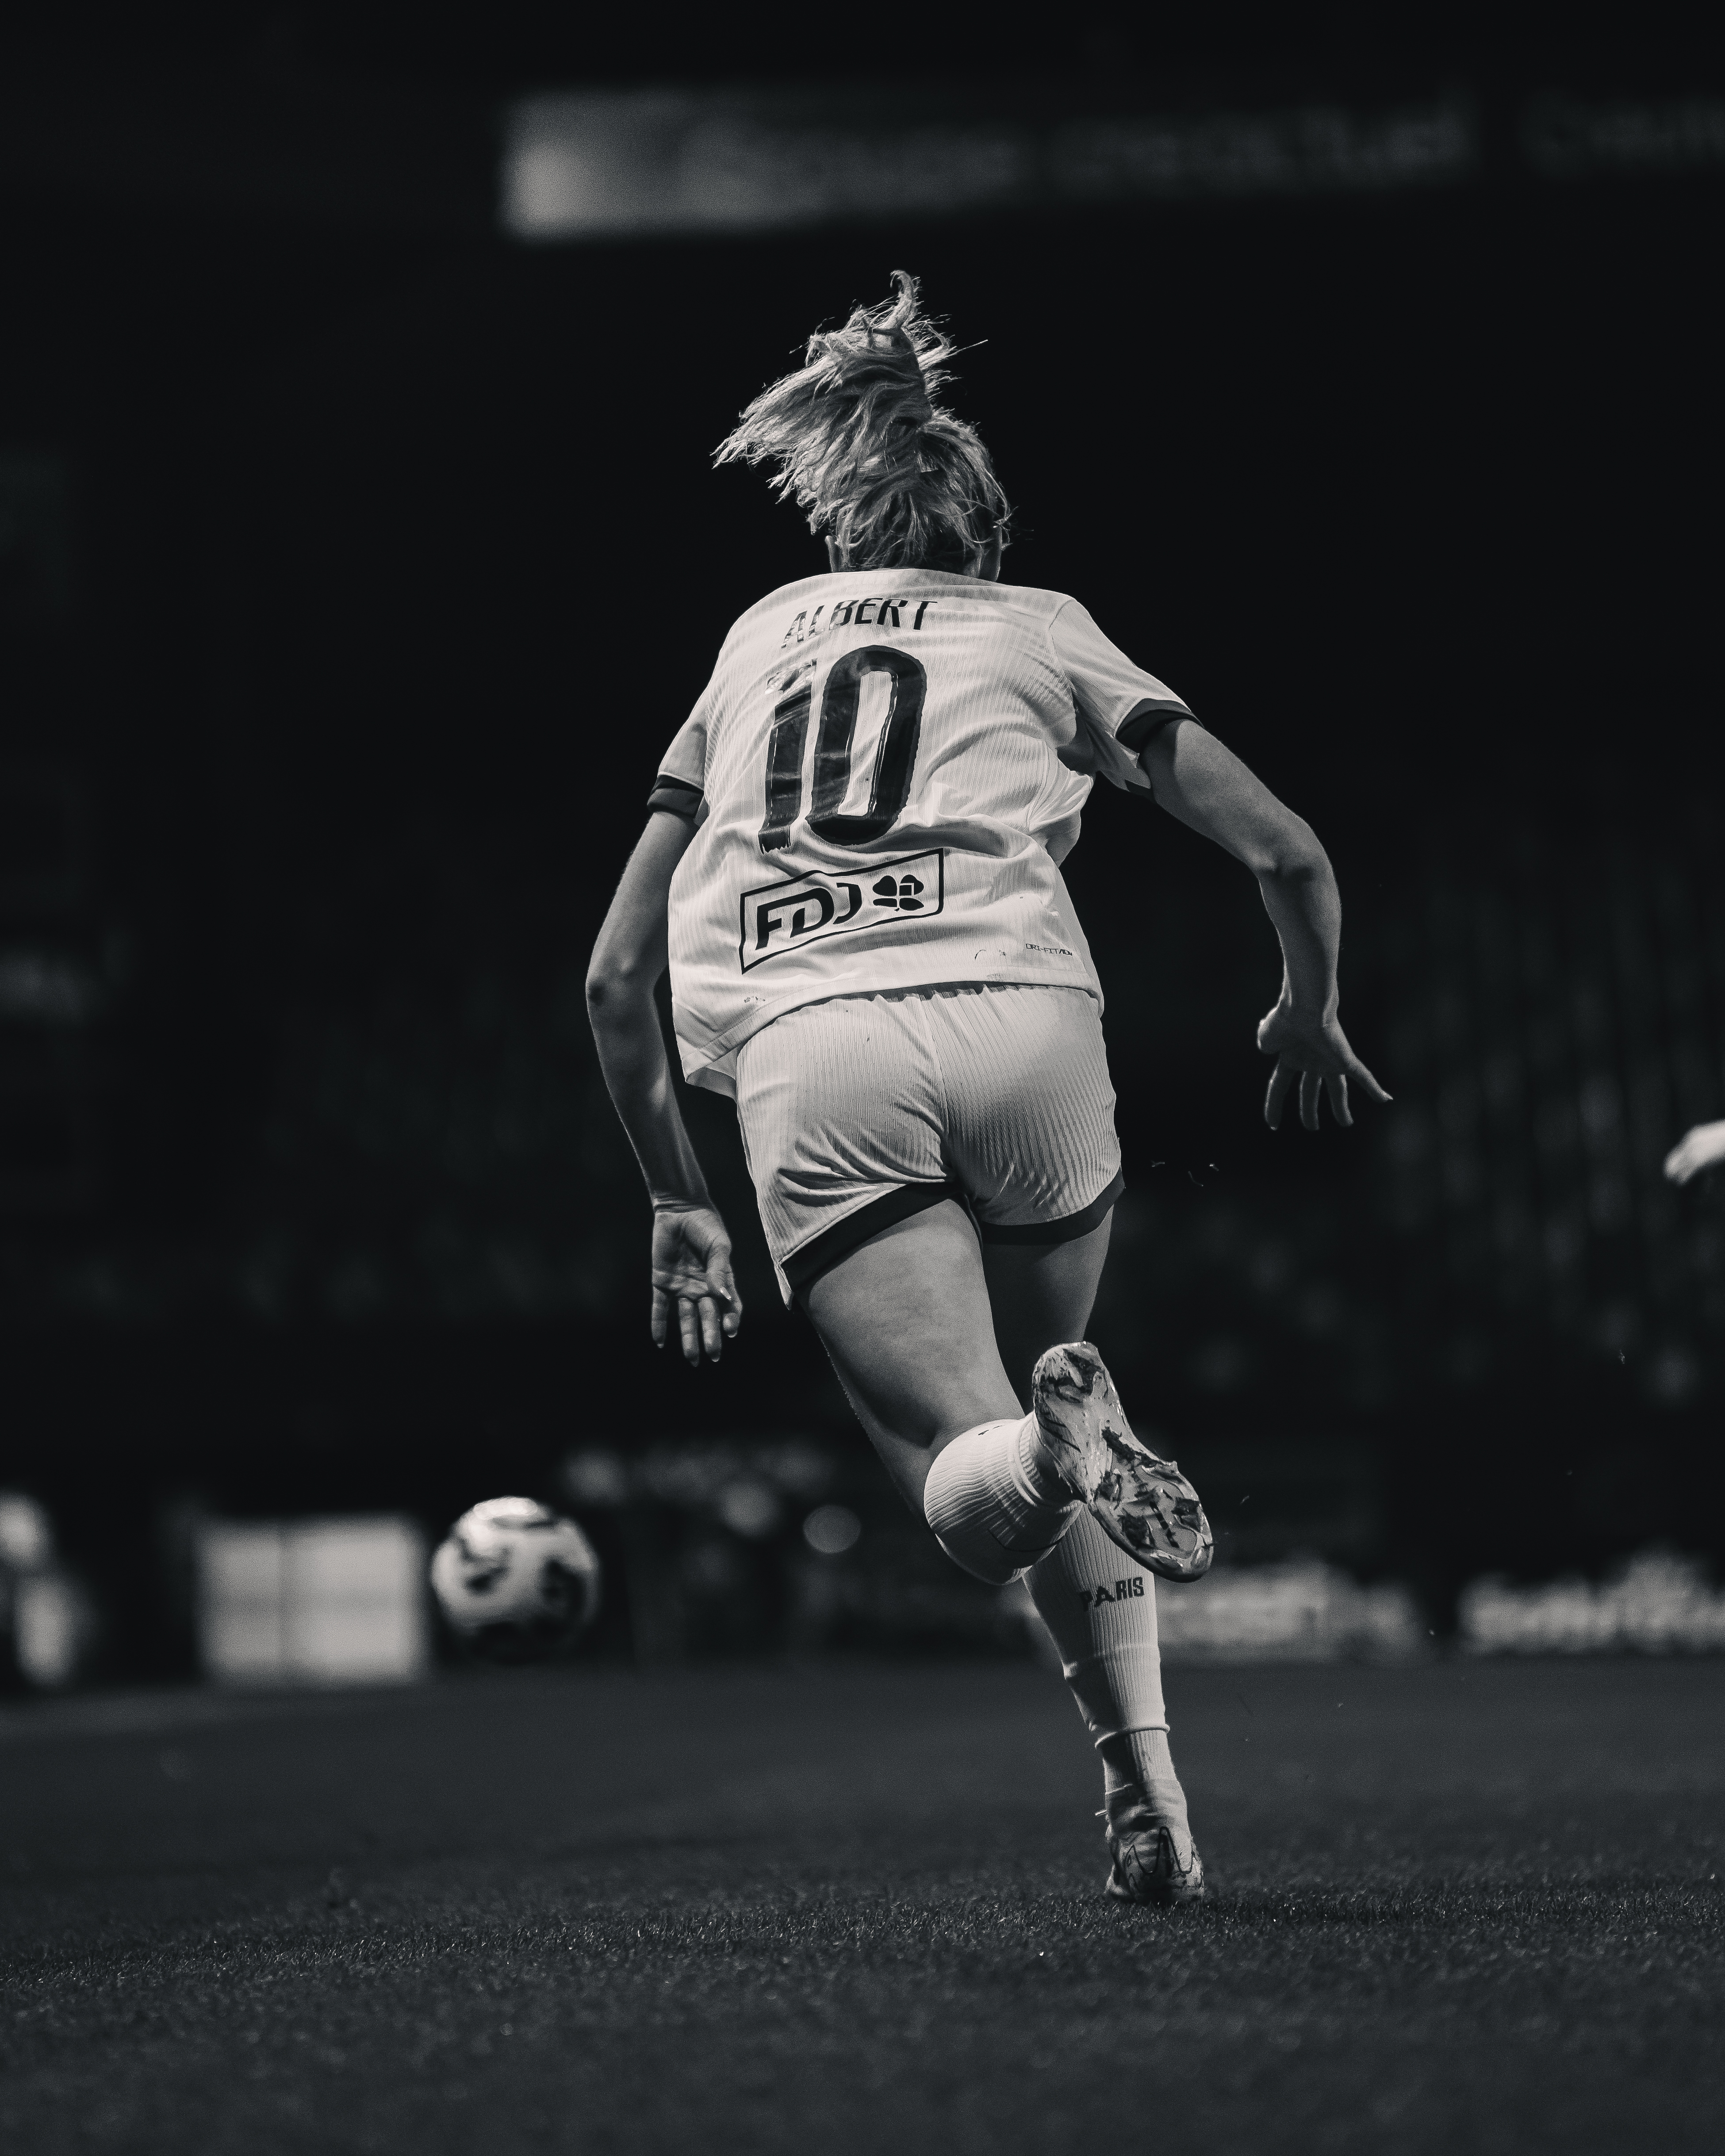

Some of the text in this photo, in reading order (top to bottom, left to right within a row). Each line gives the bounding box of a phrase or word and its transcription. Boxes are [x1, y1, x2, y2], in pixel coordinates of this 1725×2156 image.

[781, 597, 938, 648] ALBERT
[758, 645, 927, 854] 10
[755, 882, 862, 950] FDJ
[1078, 1577, 1144, 1611] PARIS
